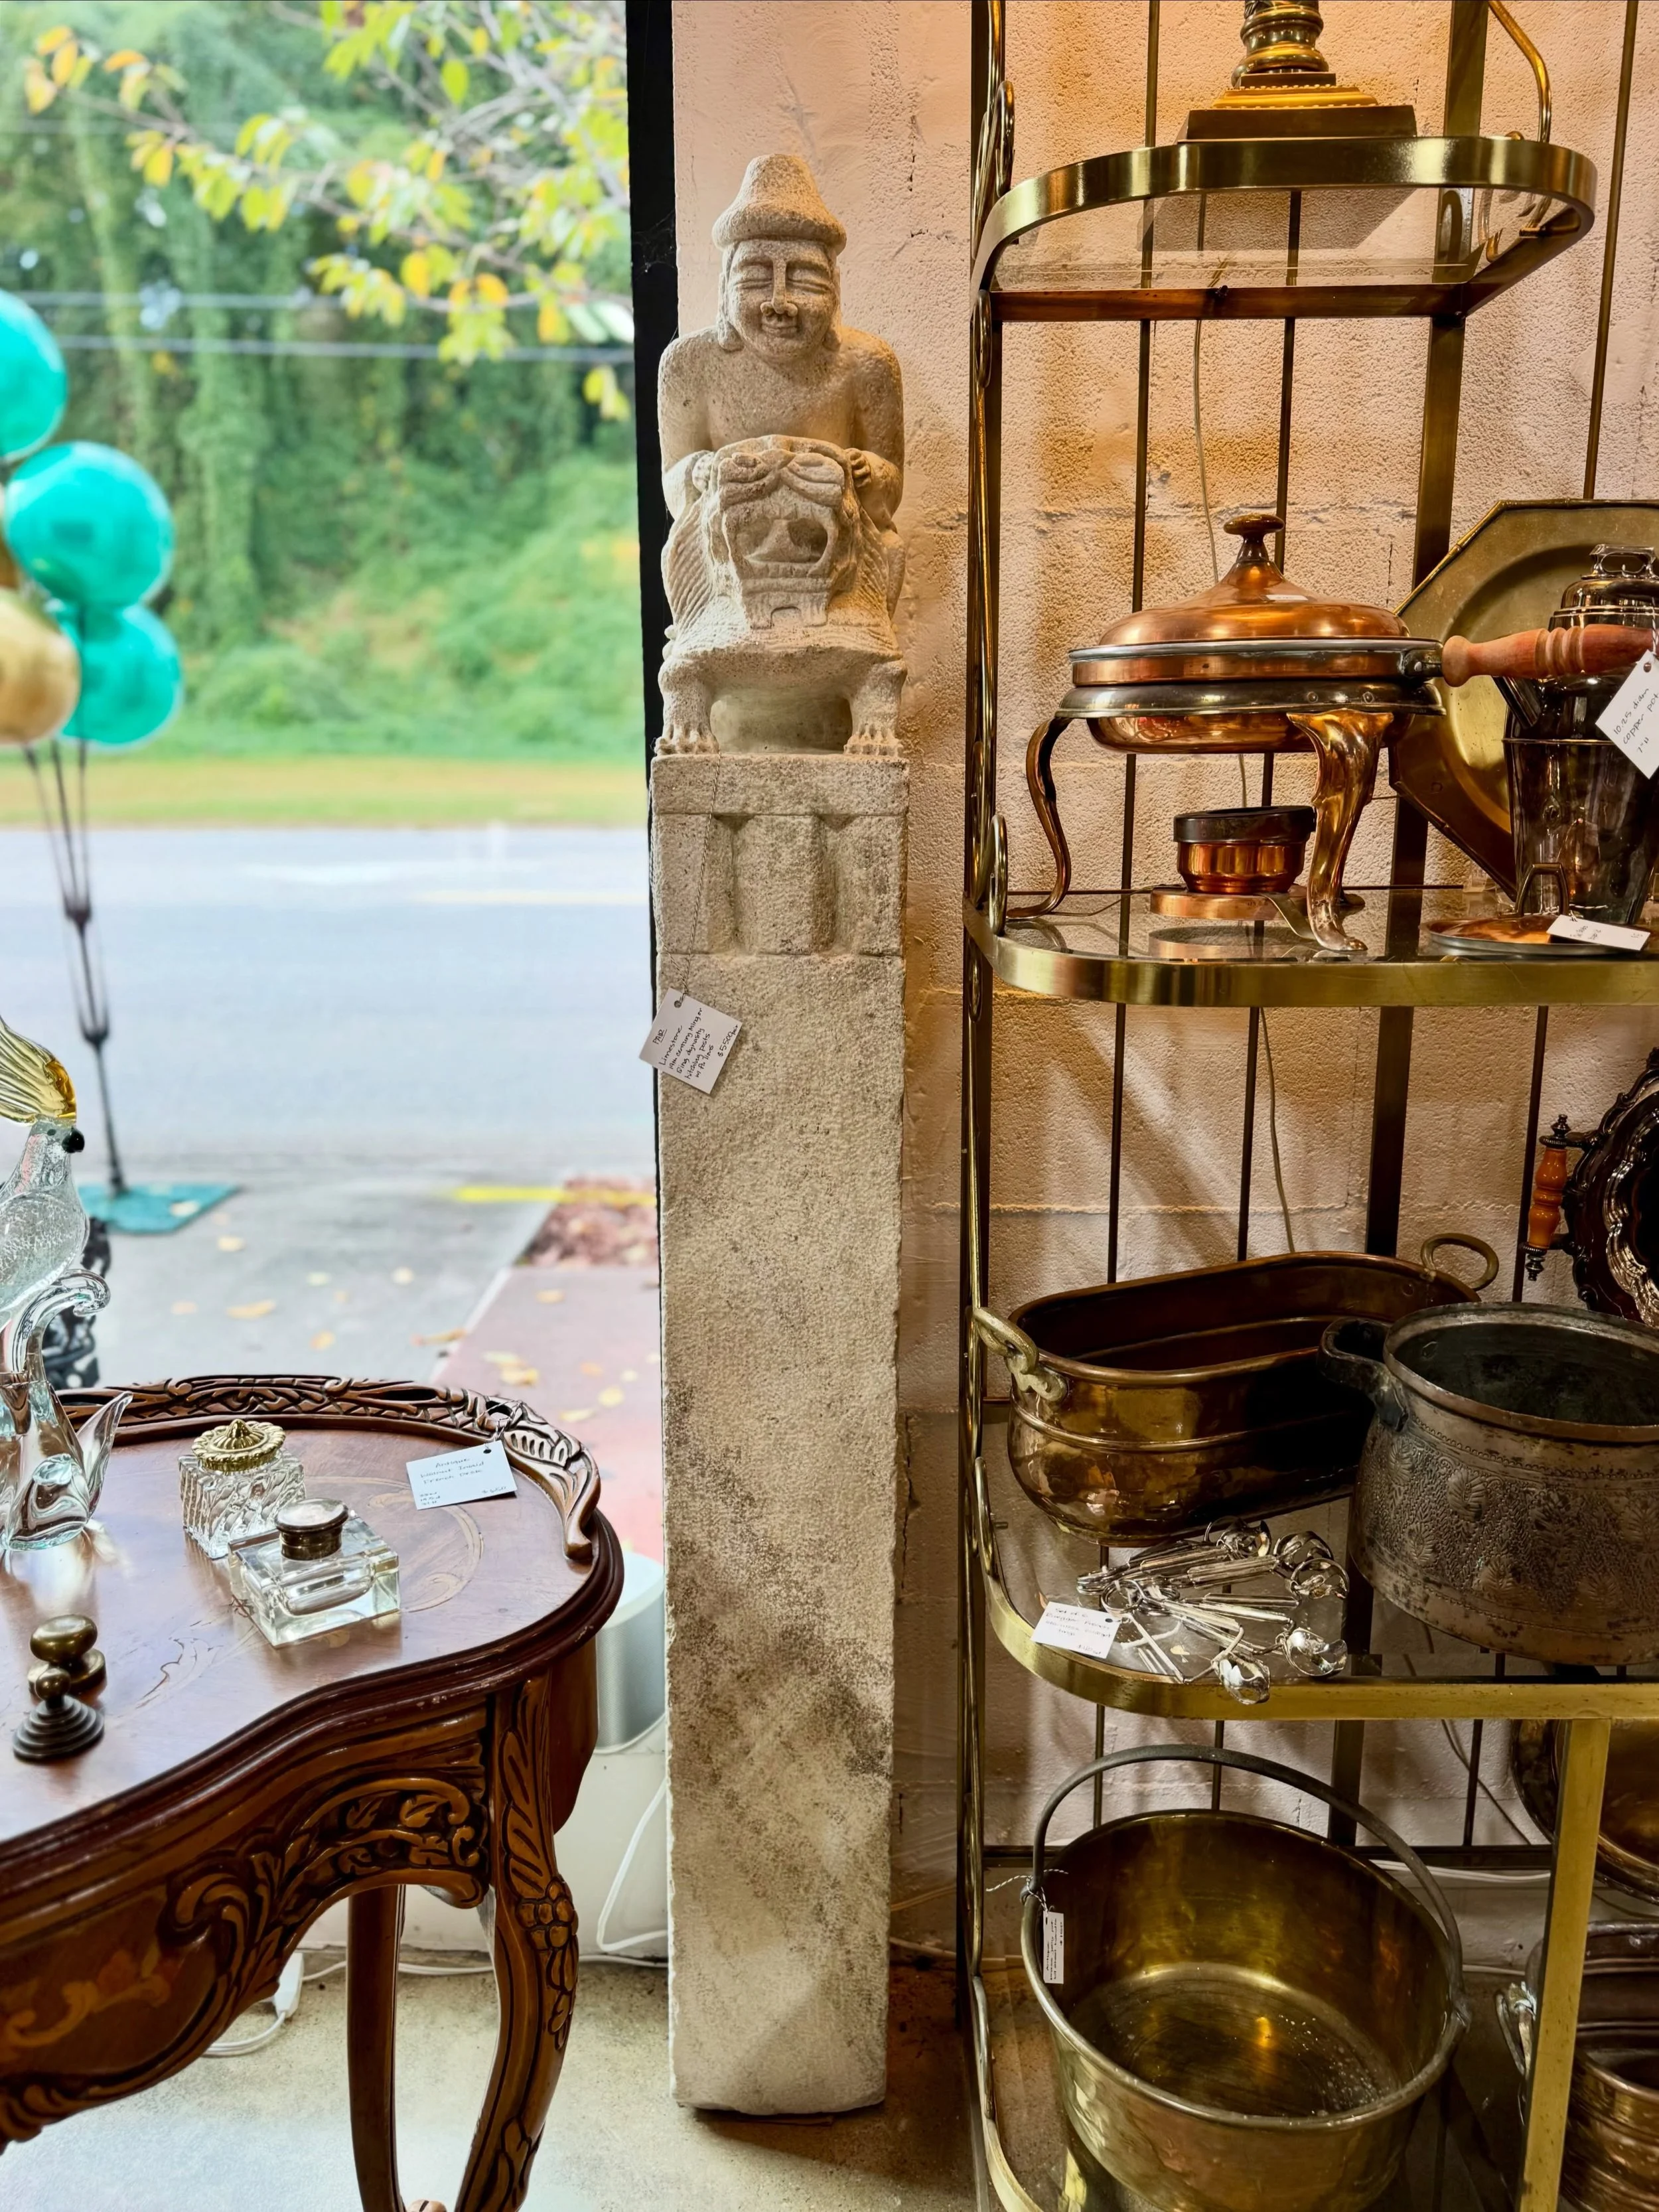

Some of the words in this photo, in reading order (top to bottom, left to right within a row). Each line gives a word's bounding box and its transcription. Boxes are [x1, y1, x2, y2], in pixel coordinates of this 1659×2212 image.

[1614, 711, 1632, 735] 10.25
[1634, 688, 1649, 709] diam
[1623, 714, 1644, 744] copper
[1647, 693, 1659, 712] pot
[653, 1029, 666, 1044] PAIR
[659, 1025, 682, 1065] Limestone
[677, 1033, 693, 1056] century
[689, 1017, 701, 1031] Ming
[677, 1058, 689, 1073] Qing
[686, 1029, 705, 1055] dynasty
[685, 1054, 703, 1079] hitching
[699, 1033, 710, 1052] posts
[705, 1045, 713, 1060] lions
